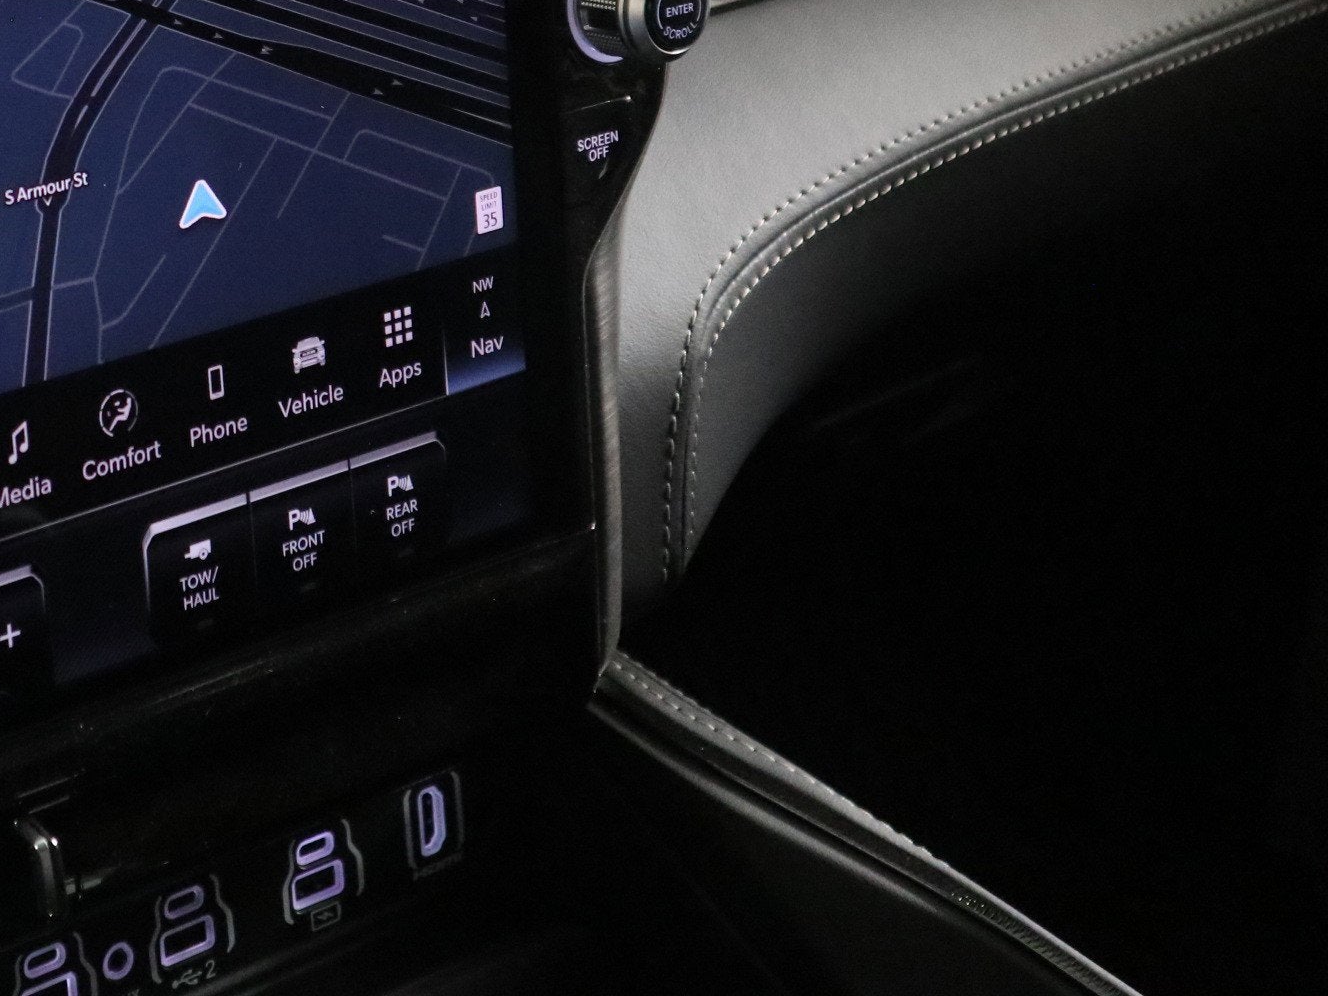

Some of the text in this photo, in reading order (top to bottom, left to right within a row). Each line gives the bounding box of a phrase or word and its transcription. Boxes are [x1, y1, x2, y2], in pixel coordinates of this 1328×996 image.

[666, 2, 694, 18] ENTER
[663, 21, 698, 40] SCROLL
[576, 130, 619, 153] SCREEN
[588, 145, 610, 162] OFF
[5, 172, 89, 205] S Armour St
[483, 211, 498, 229] 35
[473, 276, 494, 294] NW
[471, 335, 504, 359] Nav
[379, 360, 422, 389] Apps
[278, 384, 343, 418] Vehicle
[190, 415, 249, 447] Phone
[82, 440, 162, 482] Comfort
[386, 499, 418, 521] REAR
[391, 518, 416, 537] OFF
[282, 530, 325, 557] FRONT
[292, 553, 318, 572] OFF
[179, 565, 219, 592] TOW/
[183, 587, 220, 611] HAUL
[205, 959, 216, 980] 2
